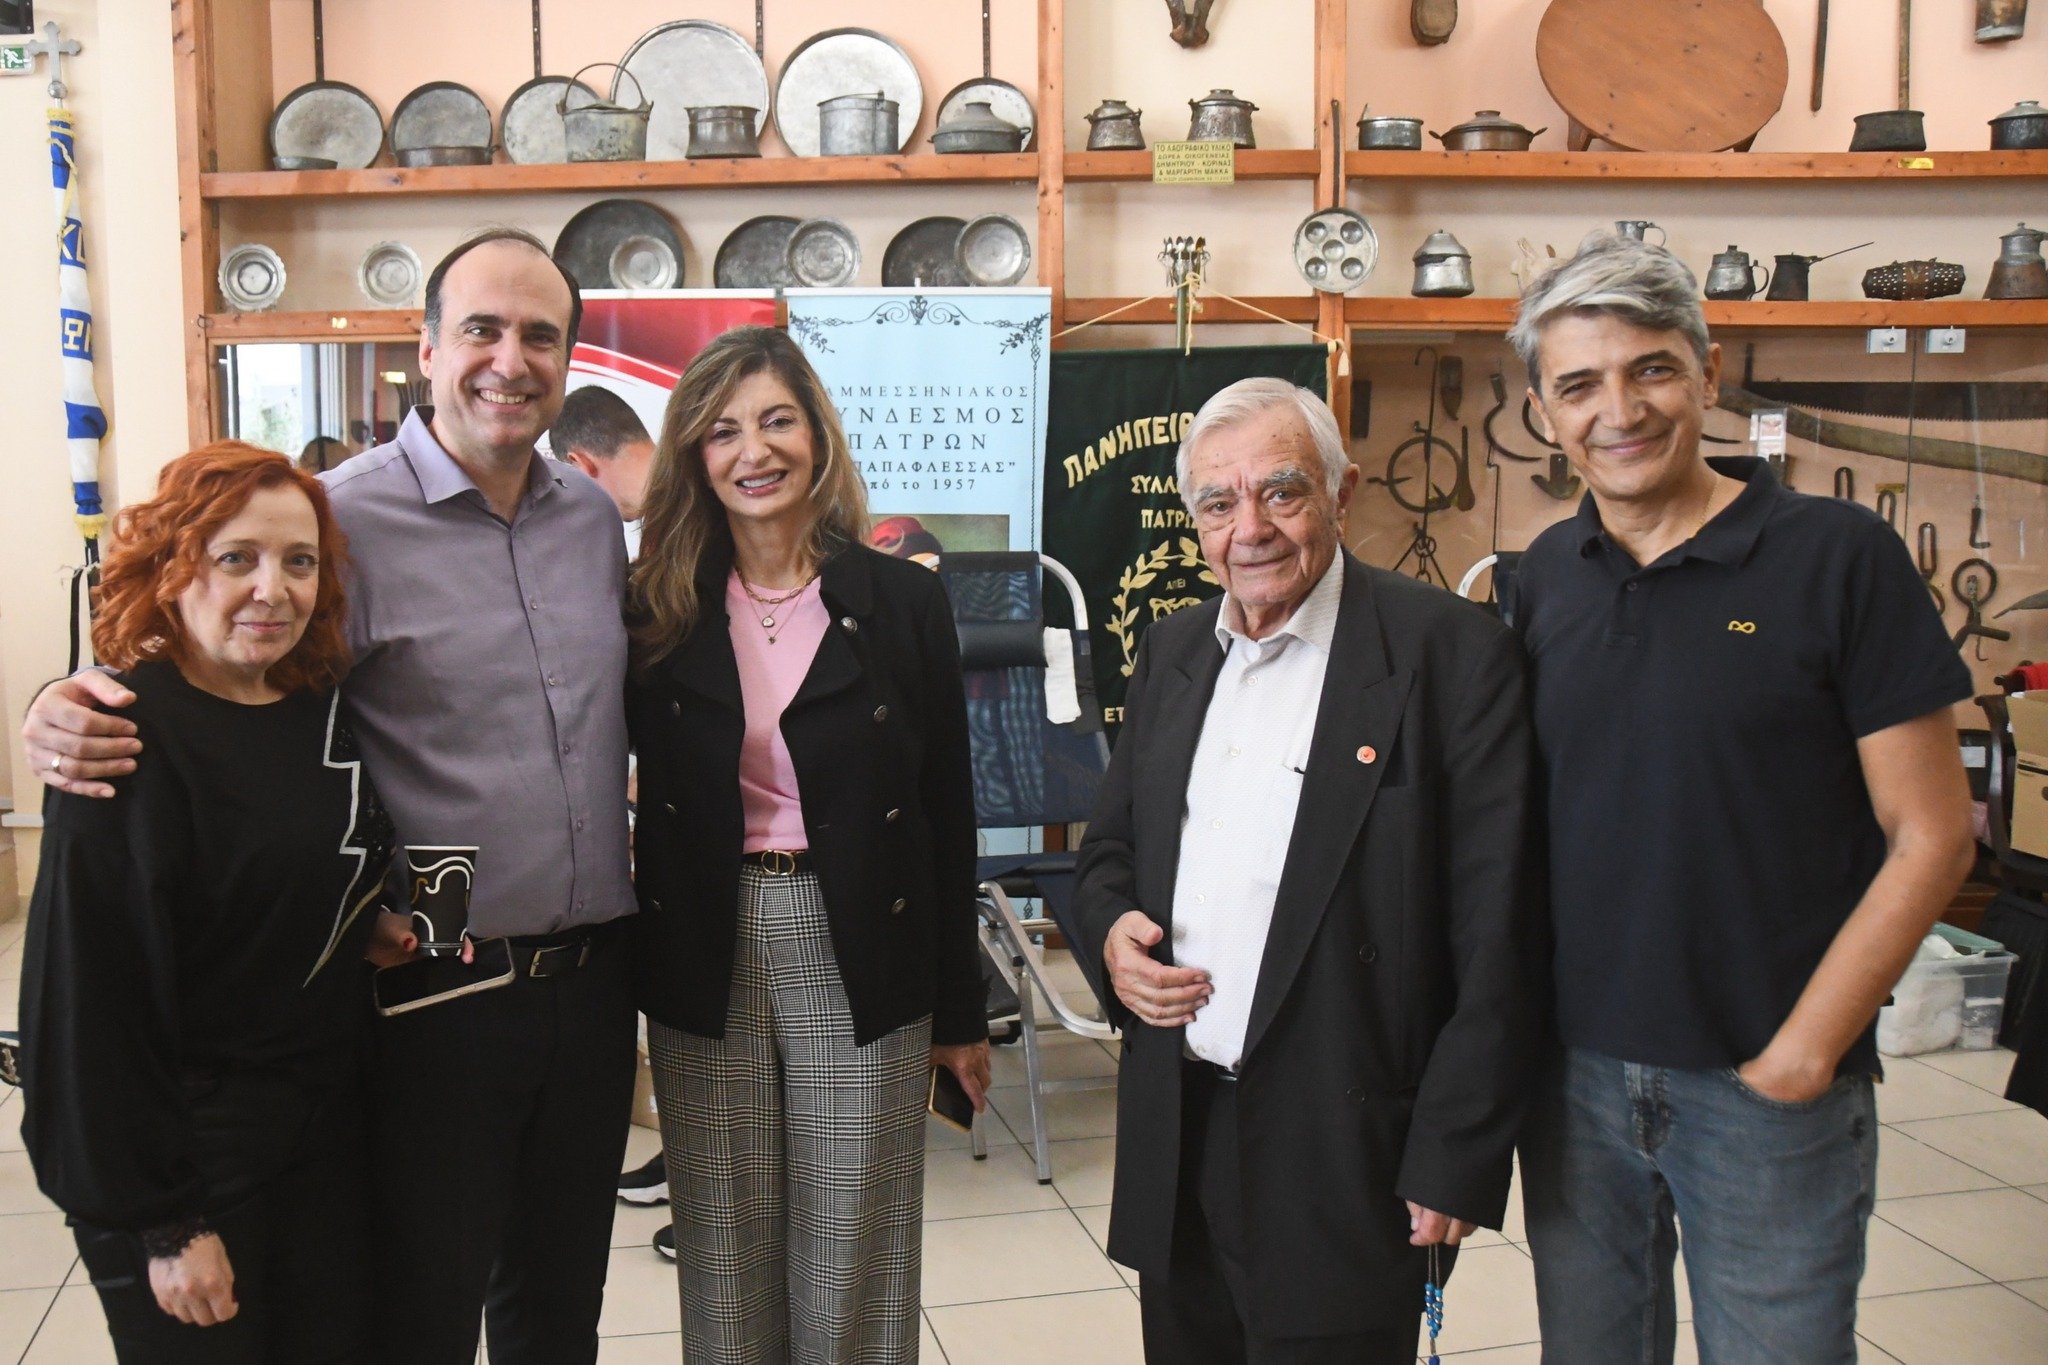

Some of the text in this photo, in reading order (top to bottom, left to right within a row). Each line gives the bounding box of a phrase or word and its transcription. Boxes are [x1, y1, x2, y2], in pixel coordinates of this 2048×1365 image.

[1156, 144, 1166, 152] ΤΟ
[827, 386, 1028, 398] ΜΜΕΣΣΗΝΙΑΚΟΣ
[836, 407, 1024, 424] ΥΝΔΕΣΜΟΣ
[848, 433, 987, 450] ΠΑΤΡΩΝ
[1063, 412, 1196, 488] ΠΑΝΗΠΕΙΡ
[870, 478, 975, 490] πό το 1957
[1131, 475, 1181, 494] ΣΥΛΛ
[1104, 706, 1125, 723] ΕΤ
